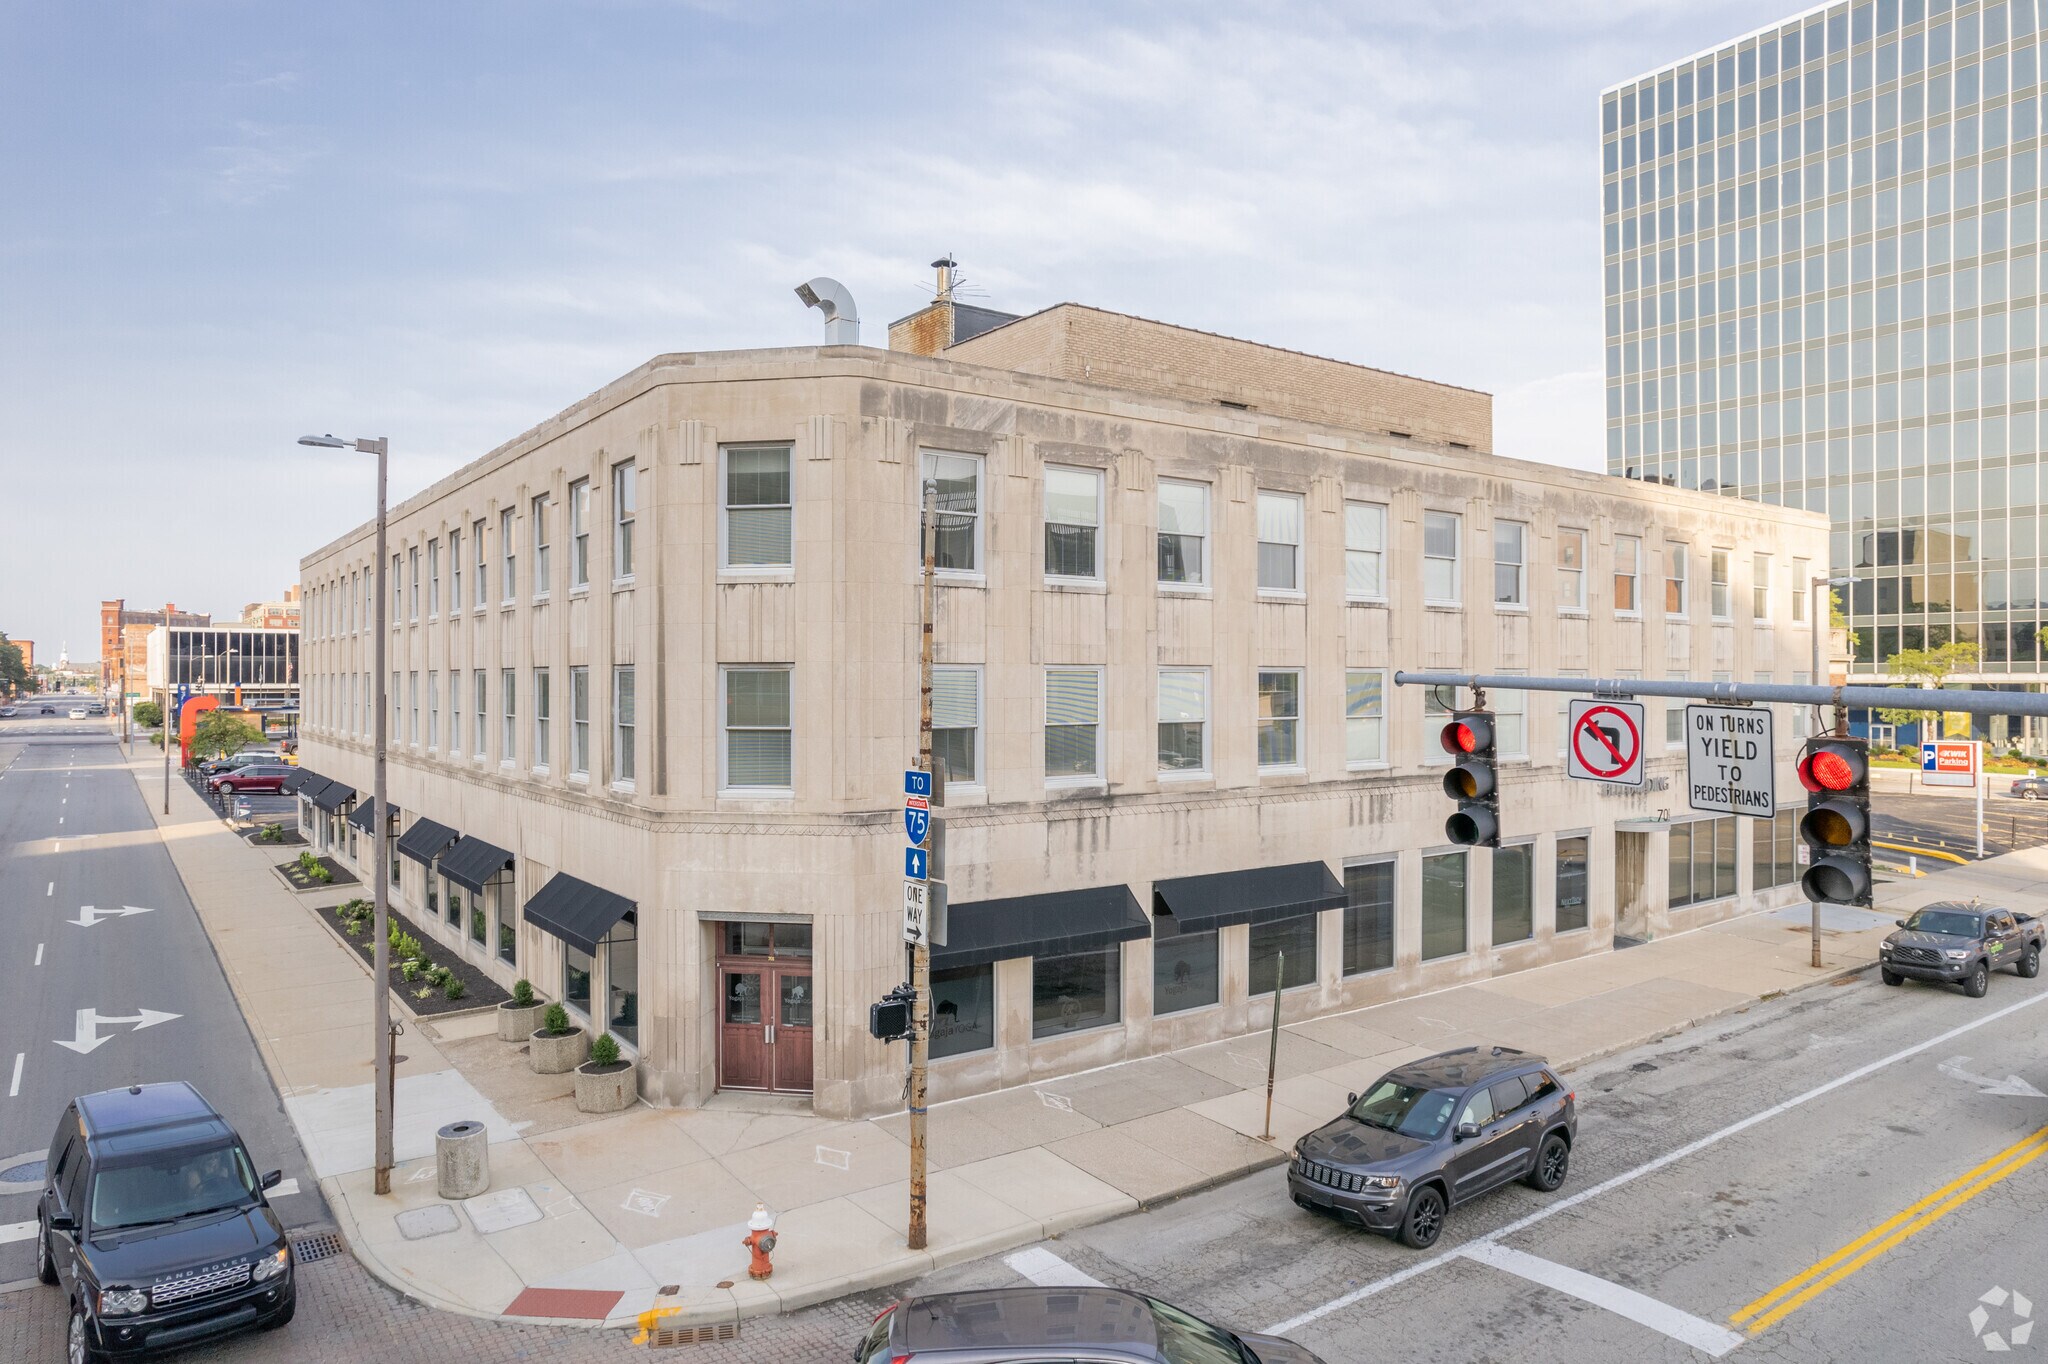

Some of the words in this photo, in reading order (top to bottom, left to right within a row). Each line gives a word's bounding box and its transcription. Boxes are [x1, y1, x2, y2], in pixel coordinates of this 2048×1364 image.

[1696, 714, 1714, 732] ON
[1720, 715, 1764, 735] TURNS
[1701, 737, 1757, 760] YIELD
[1924, 751, 1935, 764] P
[1939, 758, 1968, 766] Parking
[1717, 764, 1742, 782] TO
[911, 776, 924, 790] TO
[1694, 784, 1769, 808] PEDESTRIANS
[908, 811, 925, 835] 75
[907, 885, 923, 904] ONE
[906, 905, 923, 924] WAY
[155, 1270, 194, 1283] LAND
[202, 1257, 247, 1273] ROVER
